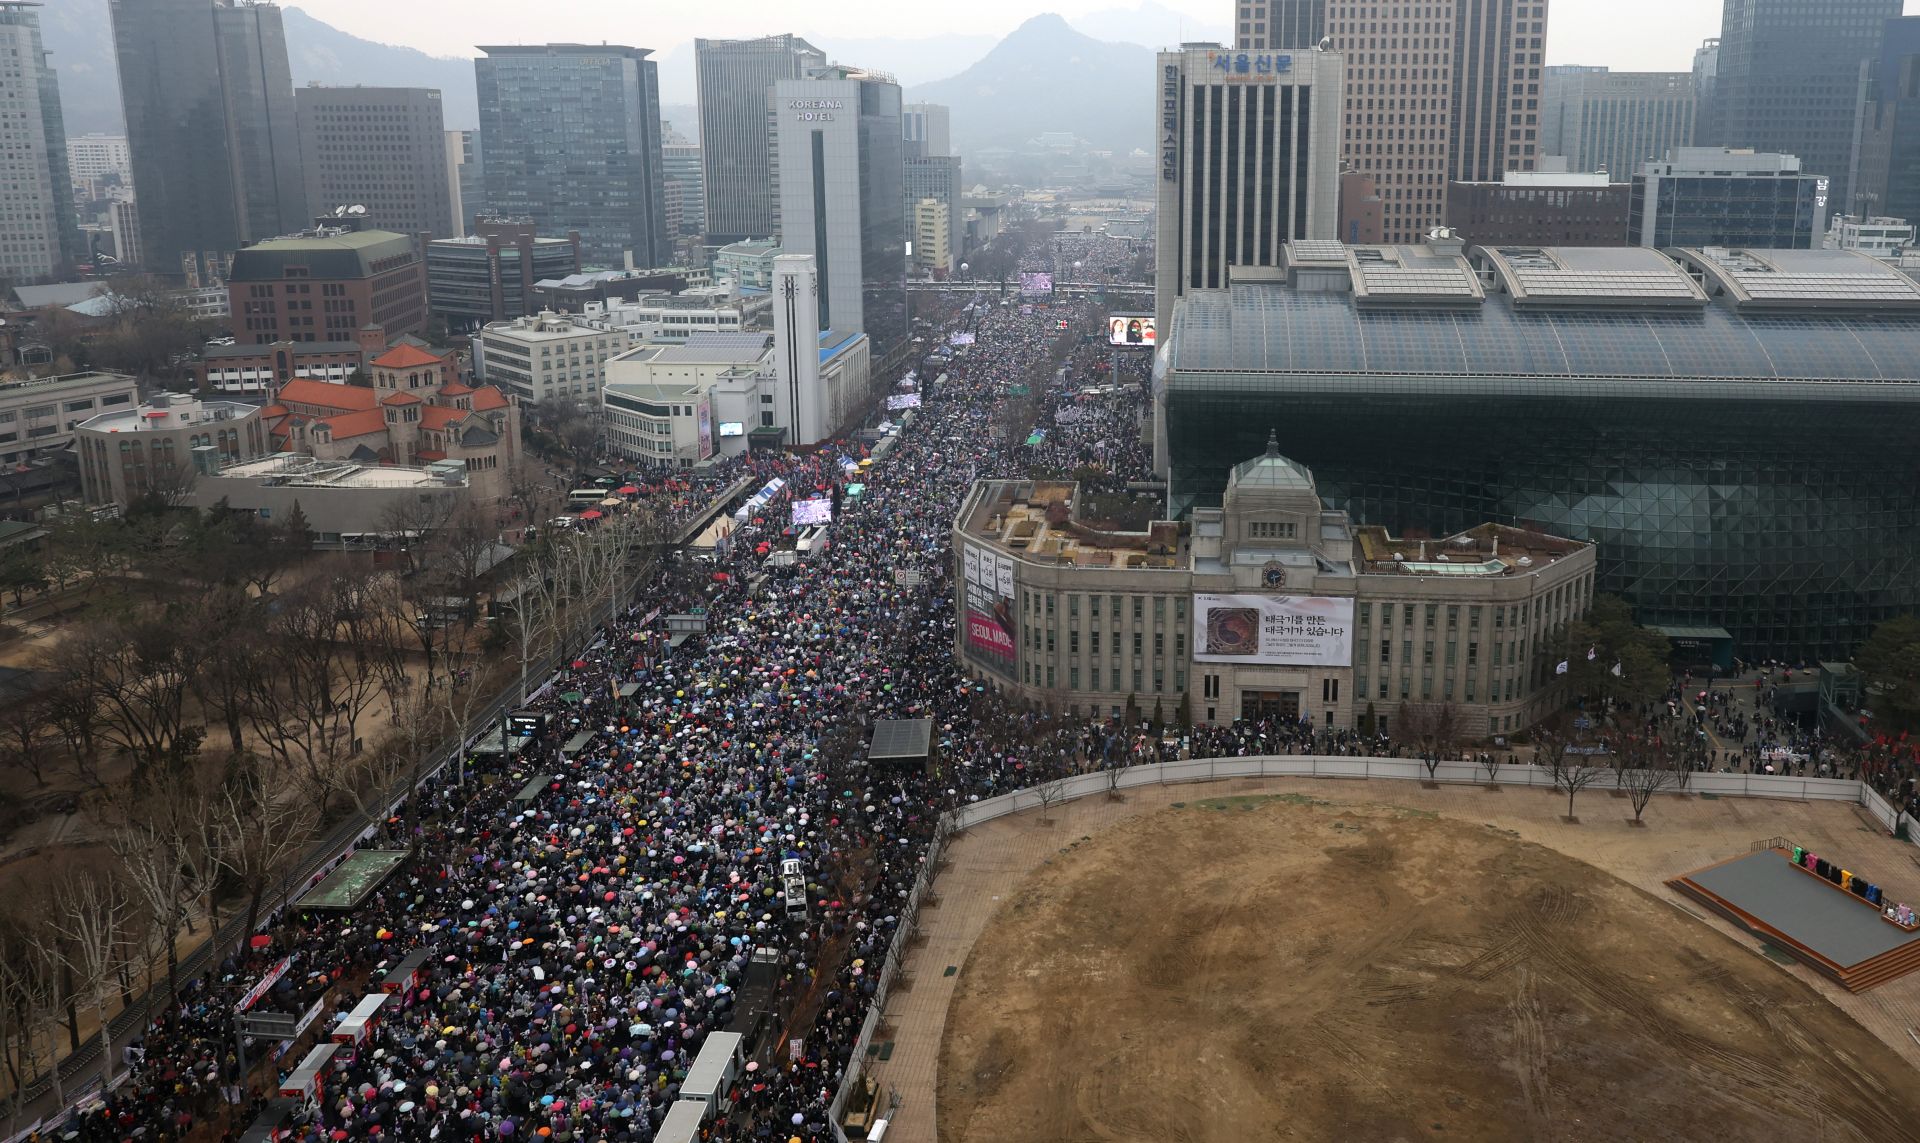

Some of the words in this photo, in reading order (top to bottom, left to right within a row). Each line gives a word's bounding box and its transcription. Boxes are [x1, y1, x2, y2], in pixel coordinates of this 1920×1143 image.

[1214, 54, 1293, 73] 서울신문
[790, 100, 843, 109] KOREANA
[797, 112, 834, 121] HOTEL
[1163, 64, 1178, 182] 한국프레스센터
[1816, 179, 1829, 207] 남강
[1265, 614, 1303, 625] 태극기를
[1306, 615, 1326, 626] 만든
[971, 622, 993, 641] SEOUL
[1265, 626, 1304, 635] 태극기가
[1306, 627, 1344, 637] 있습니다
